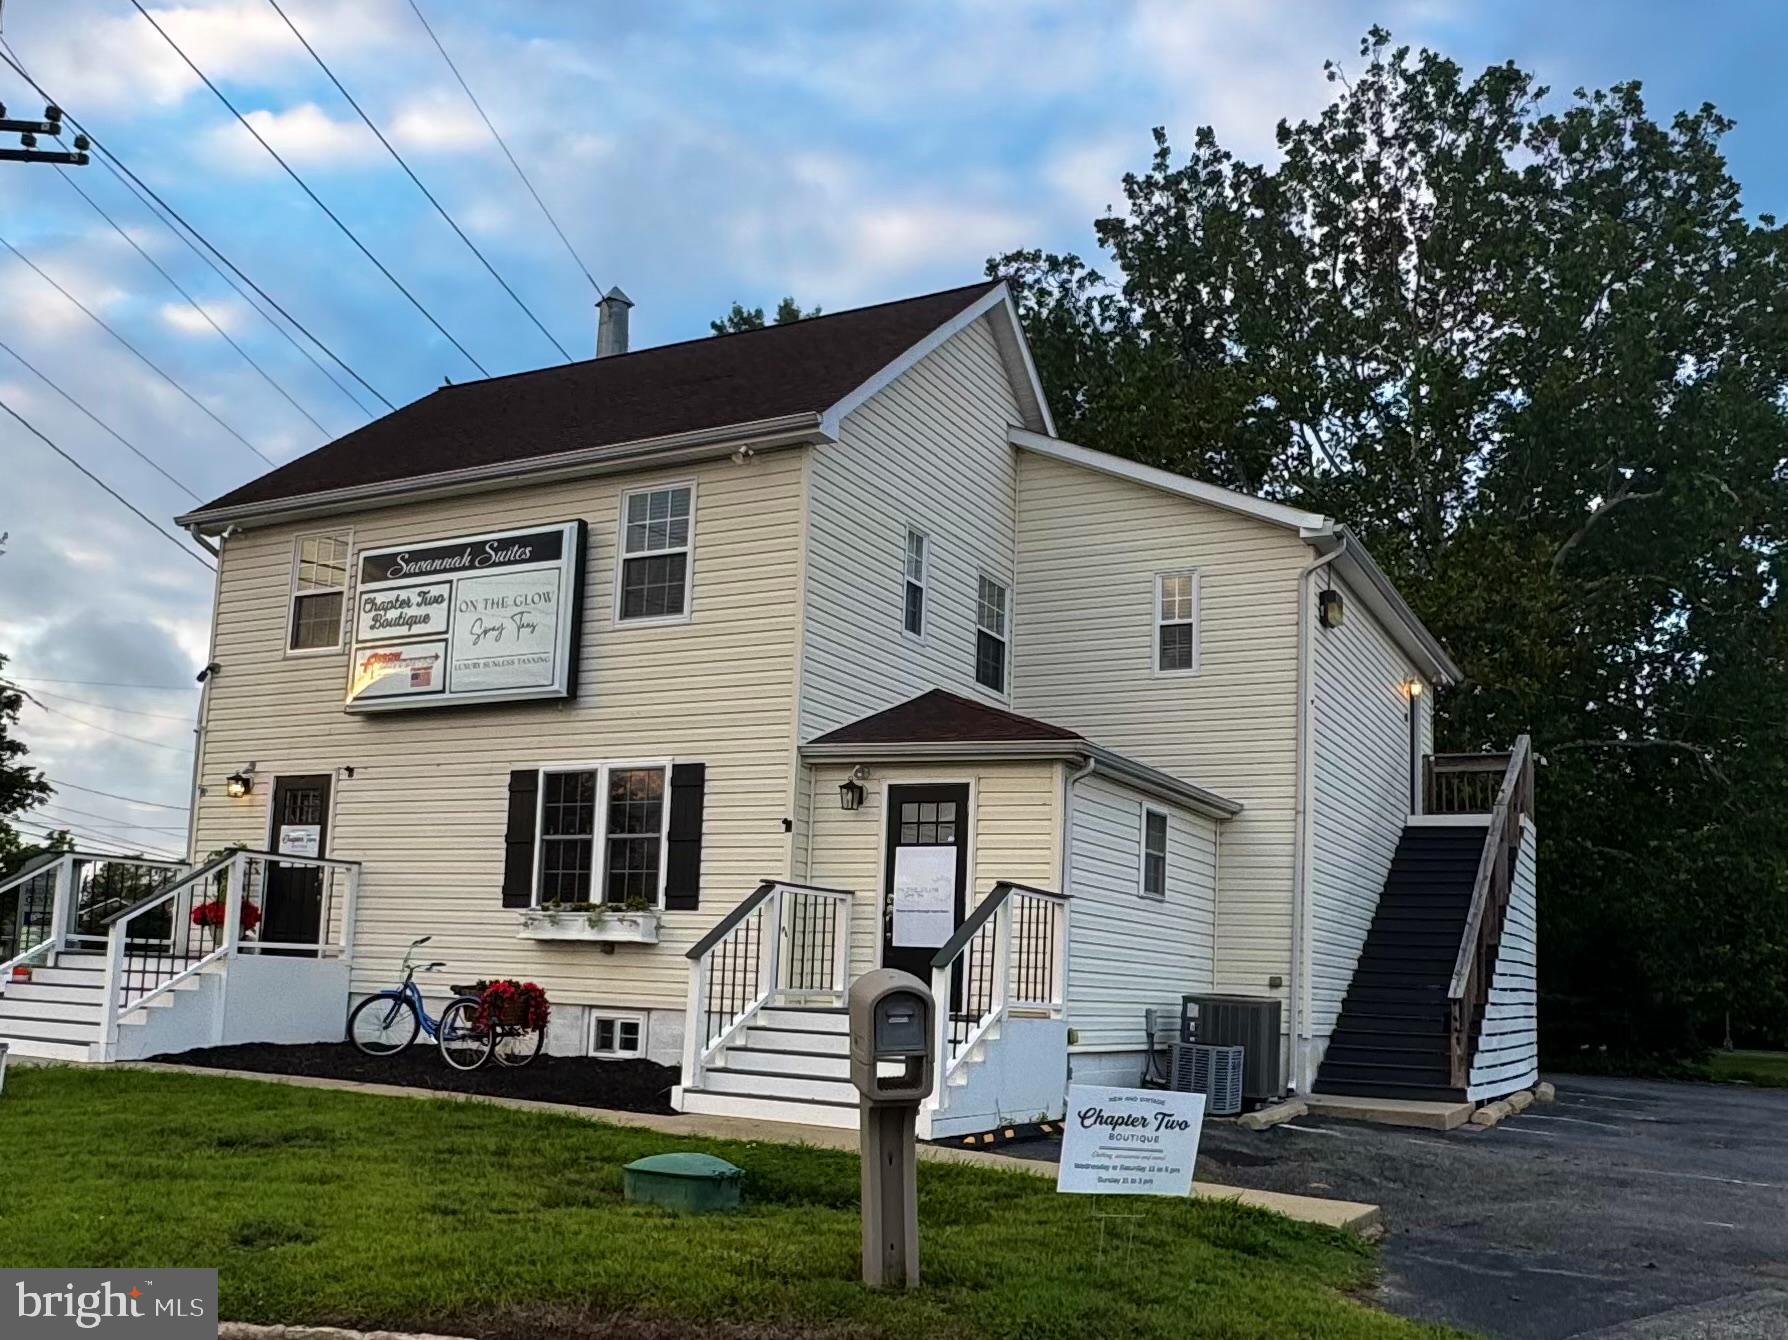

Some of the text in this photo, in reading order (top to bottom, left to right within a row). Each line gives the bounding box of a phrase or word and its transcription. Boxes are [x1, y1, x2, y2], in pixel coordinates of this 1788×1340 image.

[387, 541, 533, 578] Savannah Suites
[363, 589, 446, 616] Chapter Two
[459, 591, 555, 613] ON THE GLOW
[370, 611, 431, 632] Boutique
[482, 658, 516, 669] SUNLESS
[517, 655, 551, 666] TANNING
[1077, 1107, 1191, 1132] Chapter Two
[1108, 1133, 1160, 1144] BOUTIQUE
[1097, 1176, 1121, 1185] Sunday
